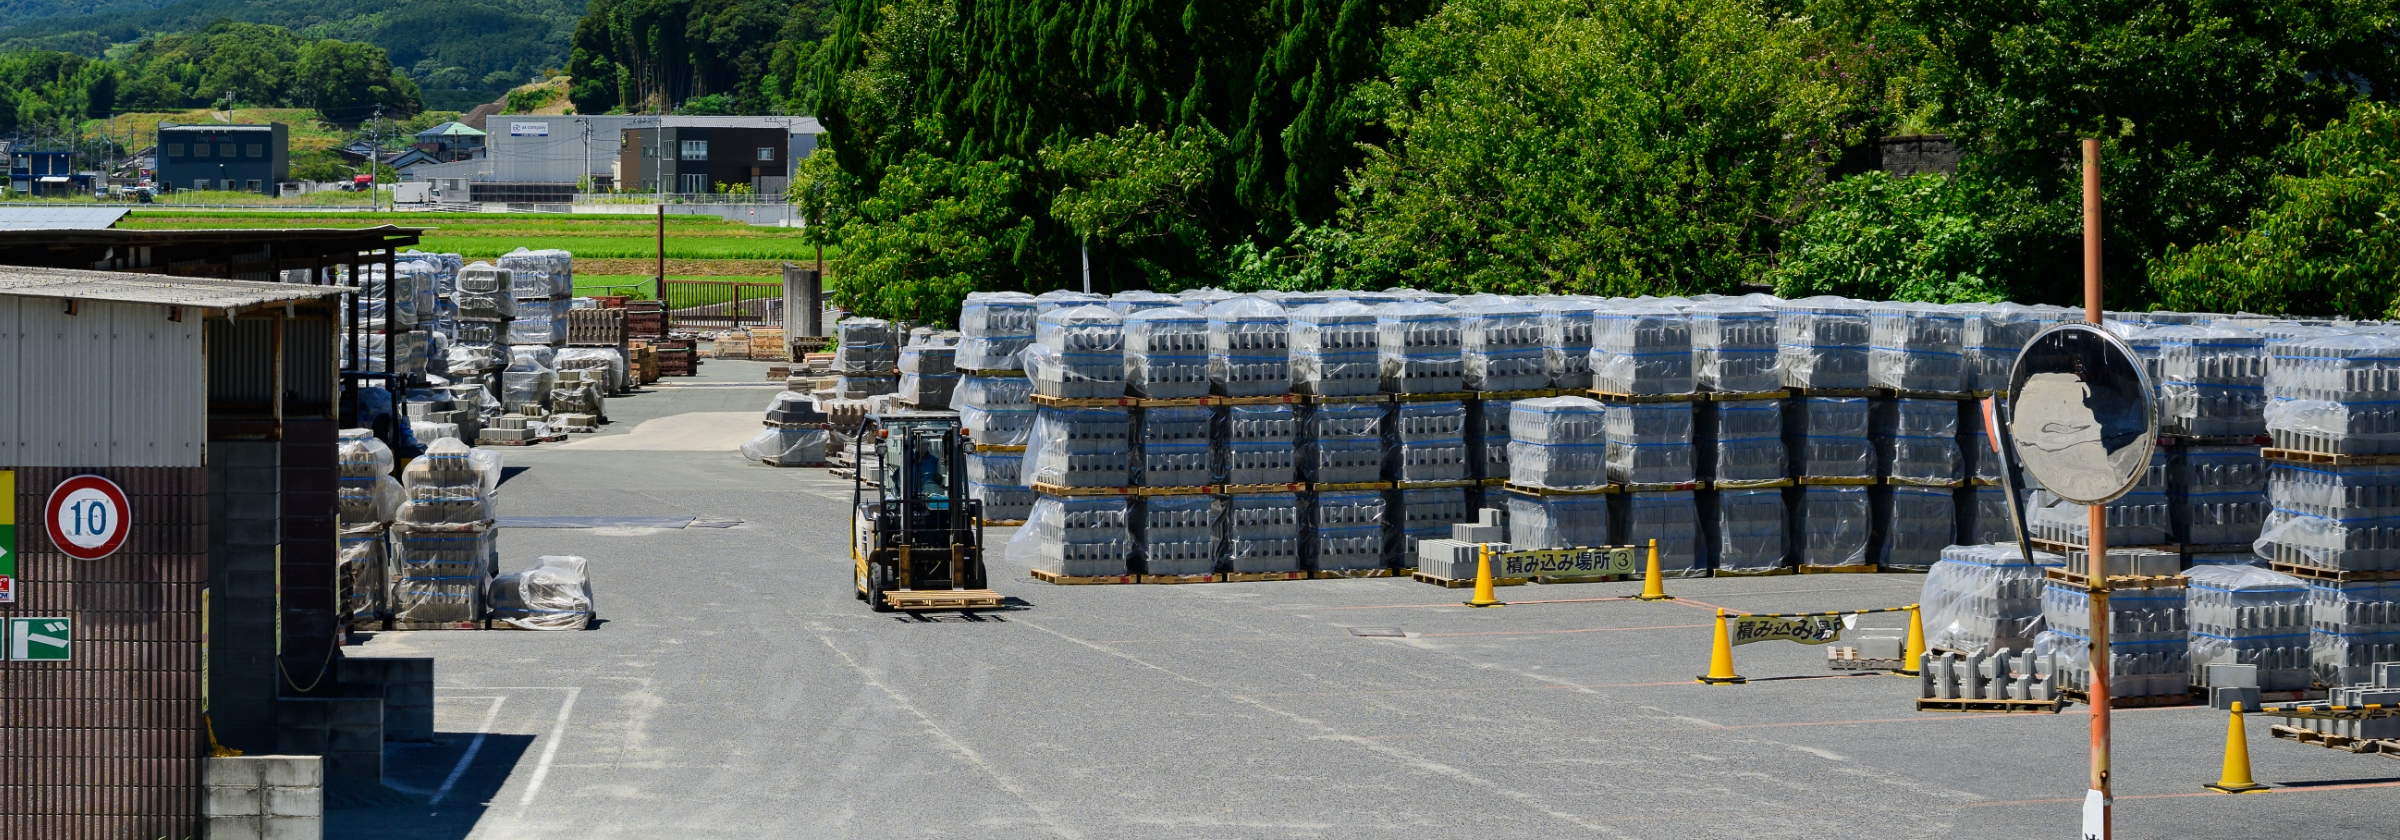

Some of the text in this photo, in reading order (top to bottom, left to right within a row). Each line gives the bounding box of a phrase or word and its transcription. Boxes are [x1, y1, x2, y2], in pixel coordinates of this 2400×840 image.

[71, 501, 107, 535] 10
[1506, 550, 1634, 575] 積み込み場所③
